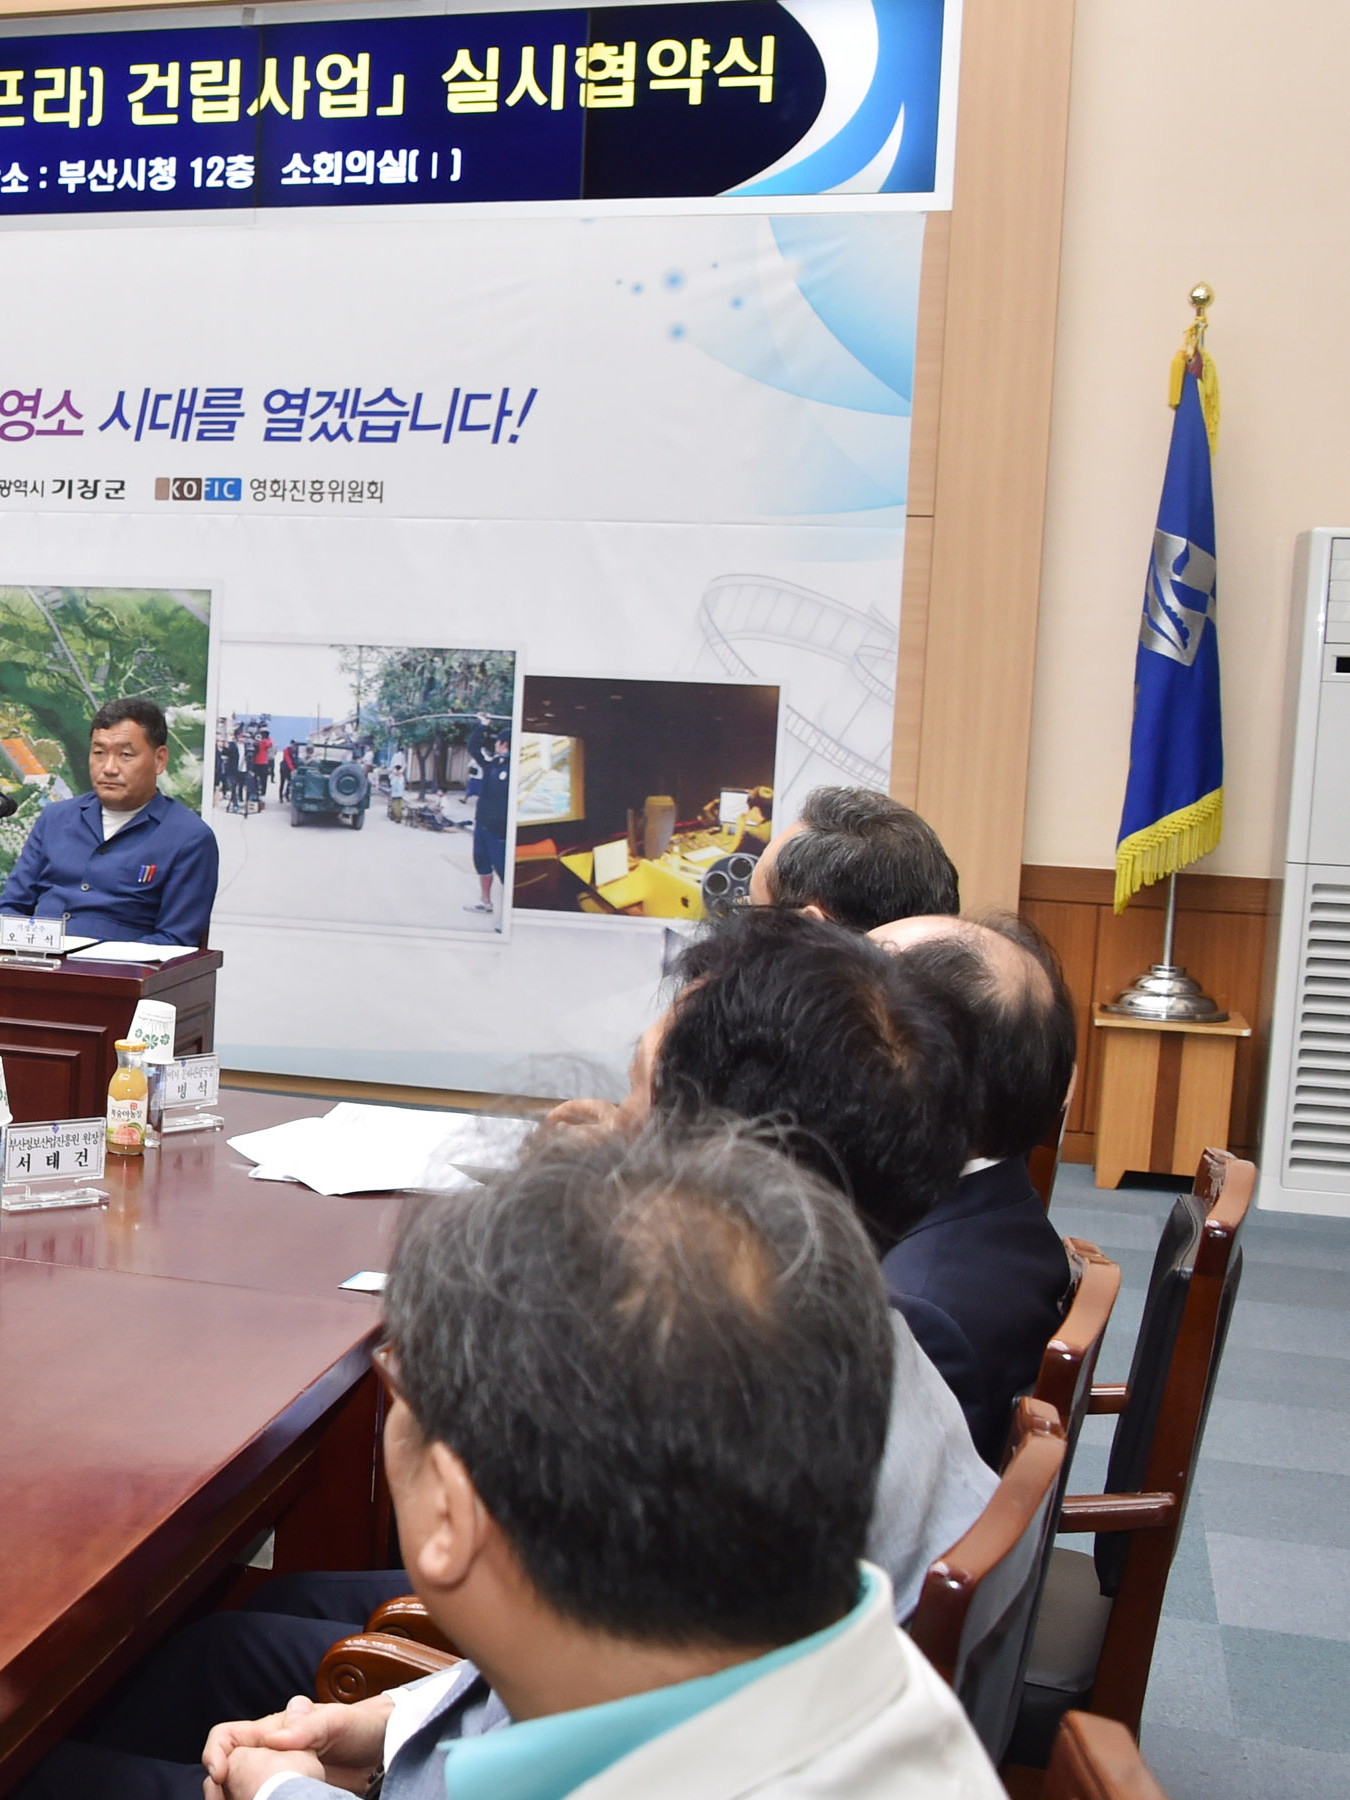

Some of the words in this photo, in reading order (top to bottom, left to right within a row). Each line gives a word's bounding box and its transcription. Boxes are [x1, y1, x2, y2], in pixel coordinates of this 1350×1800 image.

[440, 34, 776, 114] 실시협약식
[57, 156, 178, 193] 부산시청
[190, 153, 256, 190] 12층
[97, 386, 245, 442] 시대를
[262, 386, 539, 444] 열겠습니다!
[51, 478, 126, 500] 기장군
[172, 480, 236, 499] KOFIC
[249, 478, 385, 503] 영화진흥위원회
[8, 1133, 80, 1152] 부산정보산업진흥원
[83, 1130, 99, 1146] 원장
